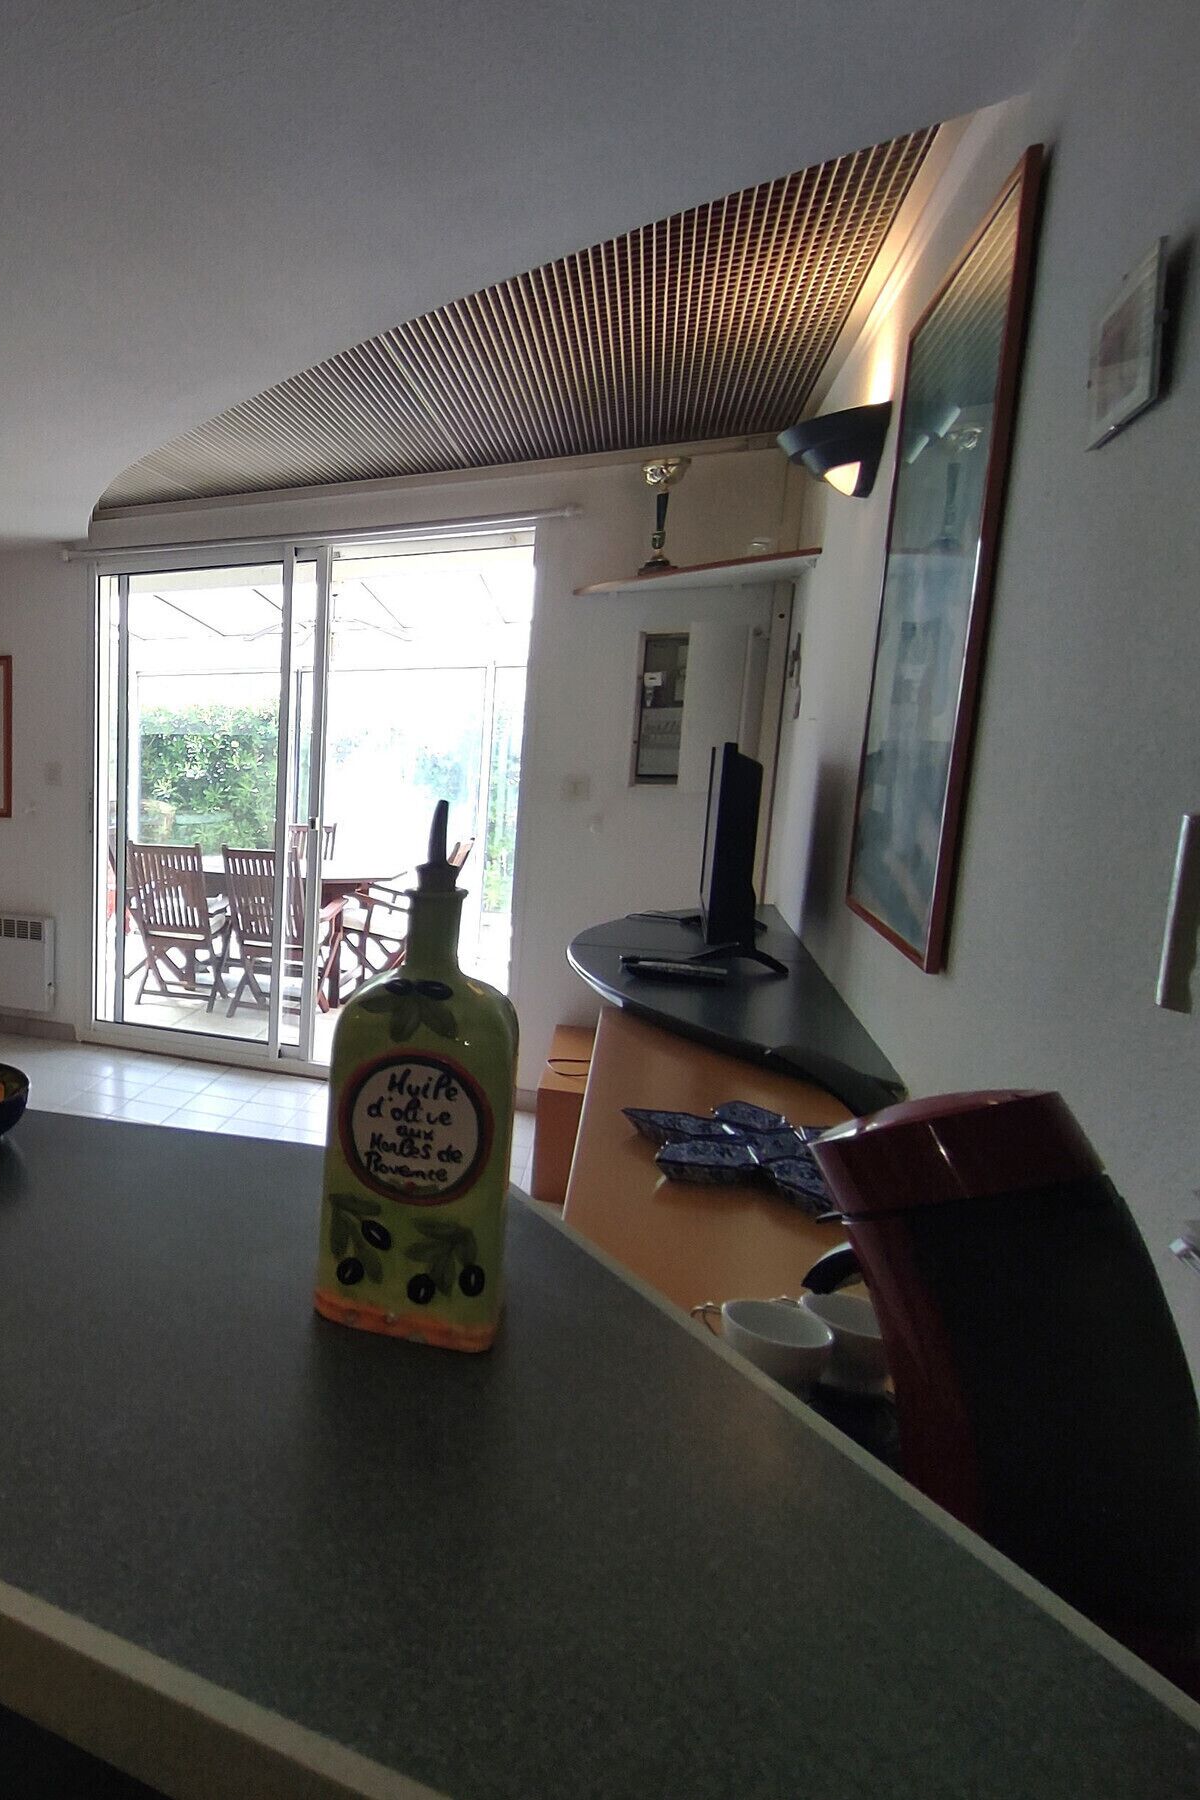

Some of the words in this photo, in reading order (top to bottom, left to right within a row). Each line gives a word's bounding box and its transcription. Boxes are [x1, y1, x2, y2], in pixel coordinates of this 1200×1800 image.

[387, 1069, 459, 1101] Huile
[367, 1096, 453, 1126] d'olive
[396, 1125, 434, 1141] aux
[364, 1151, 448, 1182] Provence
[437, 1144, 463, 1164] de
